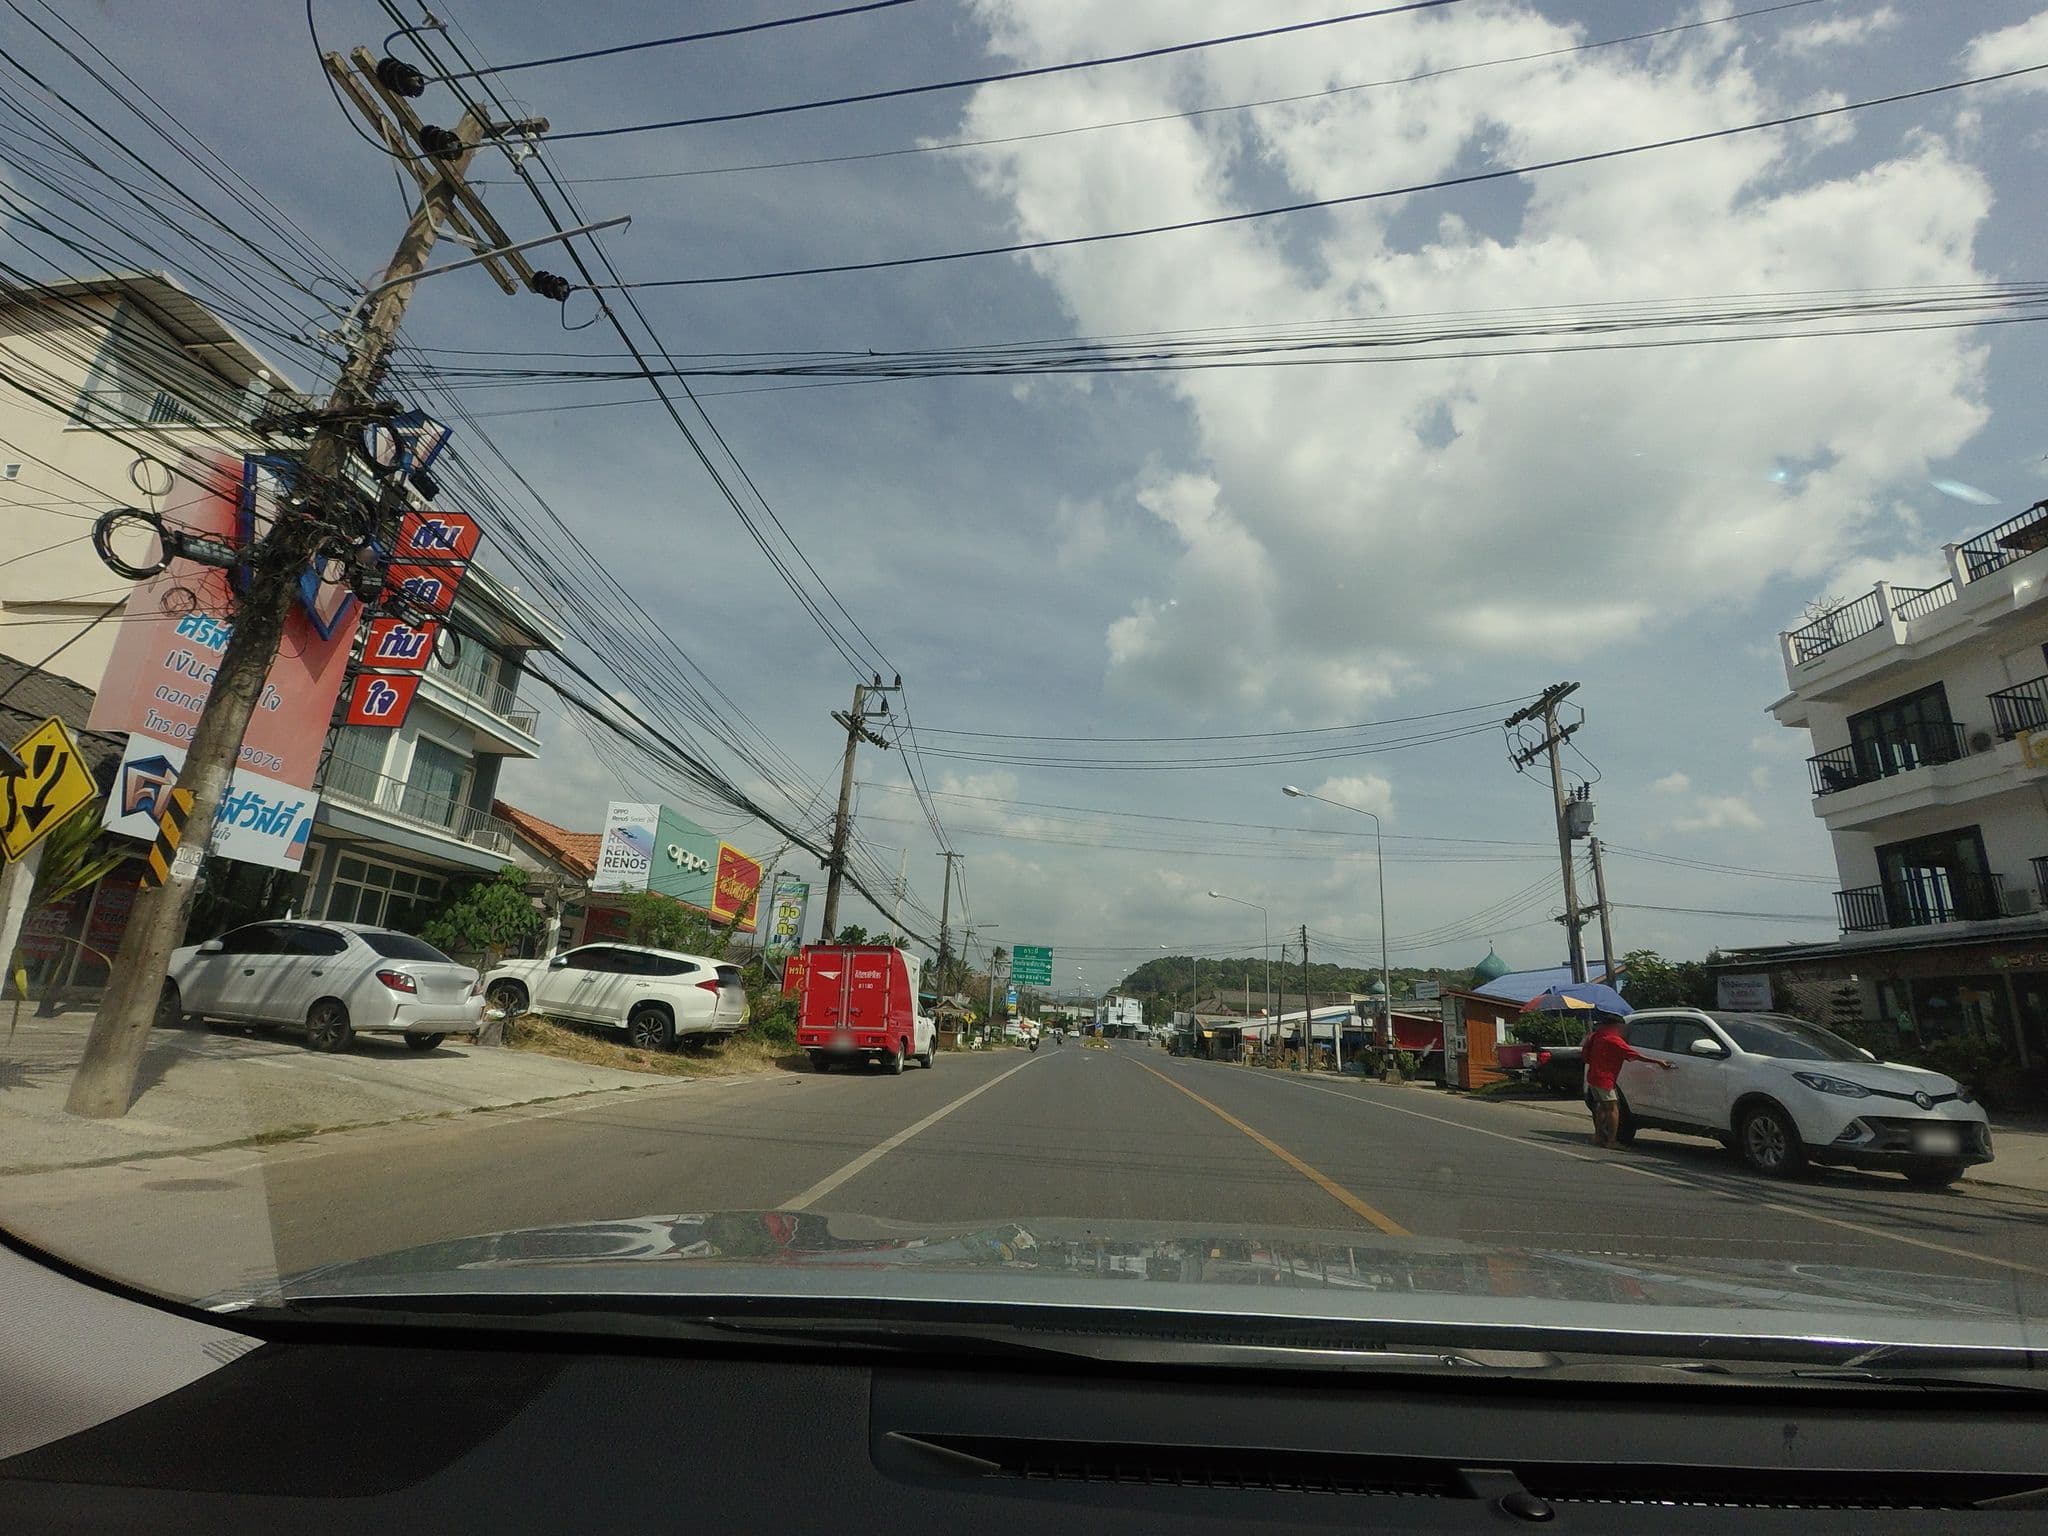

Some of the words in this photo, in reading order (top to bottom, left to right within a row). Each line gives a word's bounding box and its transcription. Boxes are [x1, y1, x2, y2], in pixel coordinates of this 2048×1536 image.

[411, 519, 464, 550] เงิน
[363, 680, 399, 716] ใจ
[604, 857, 647, 870] RENO5
